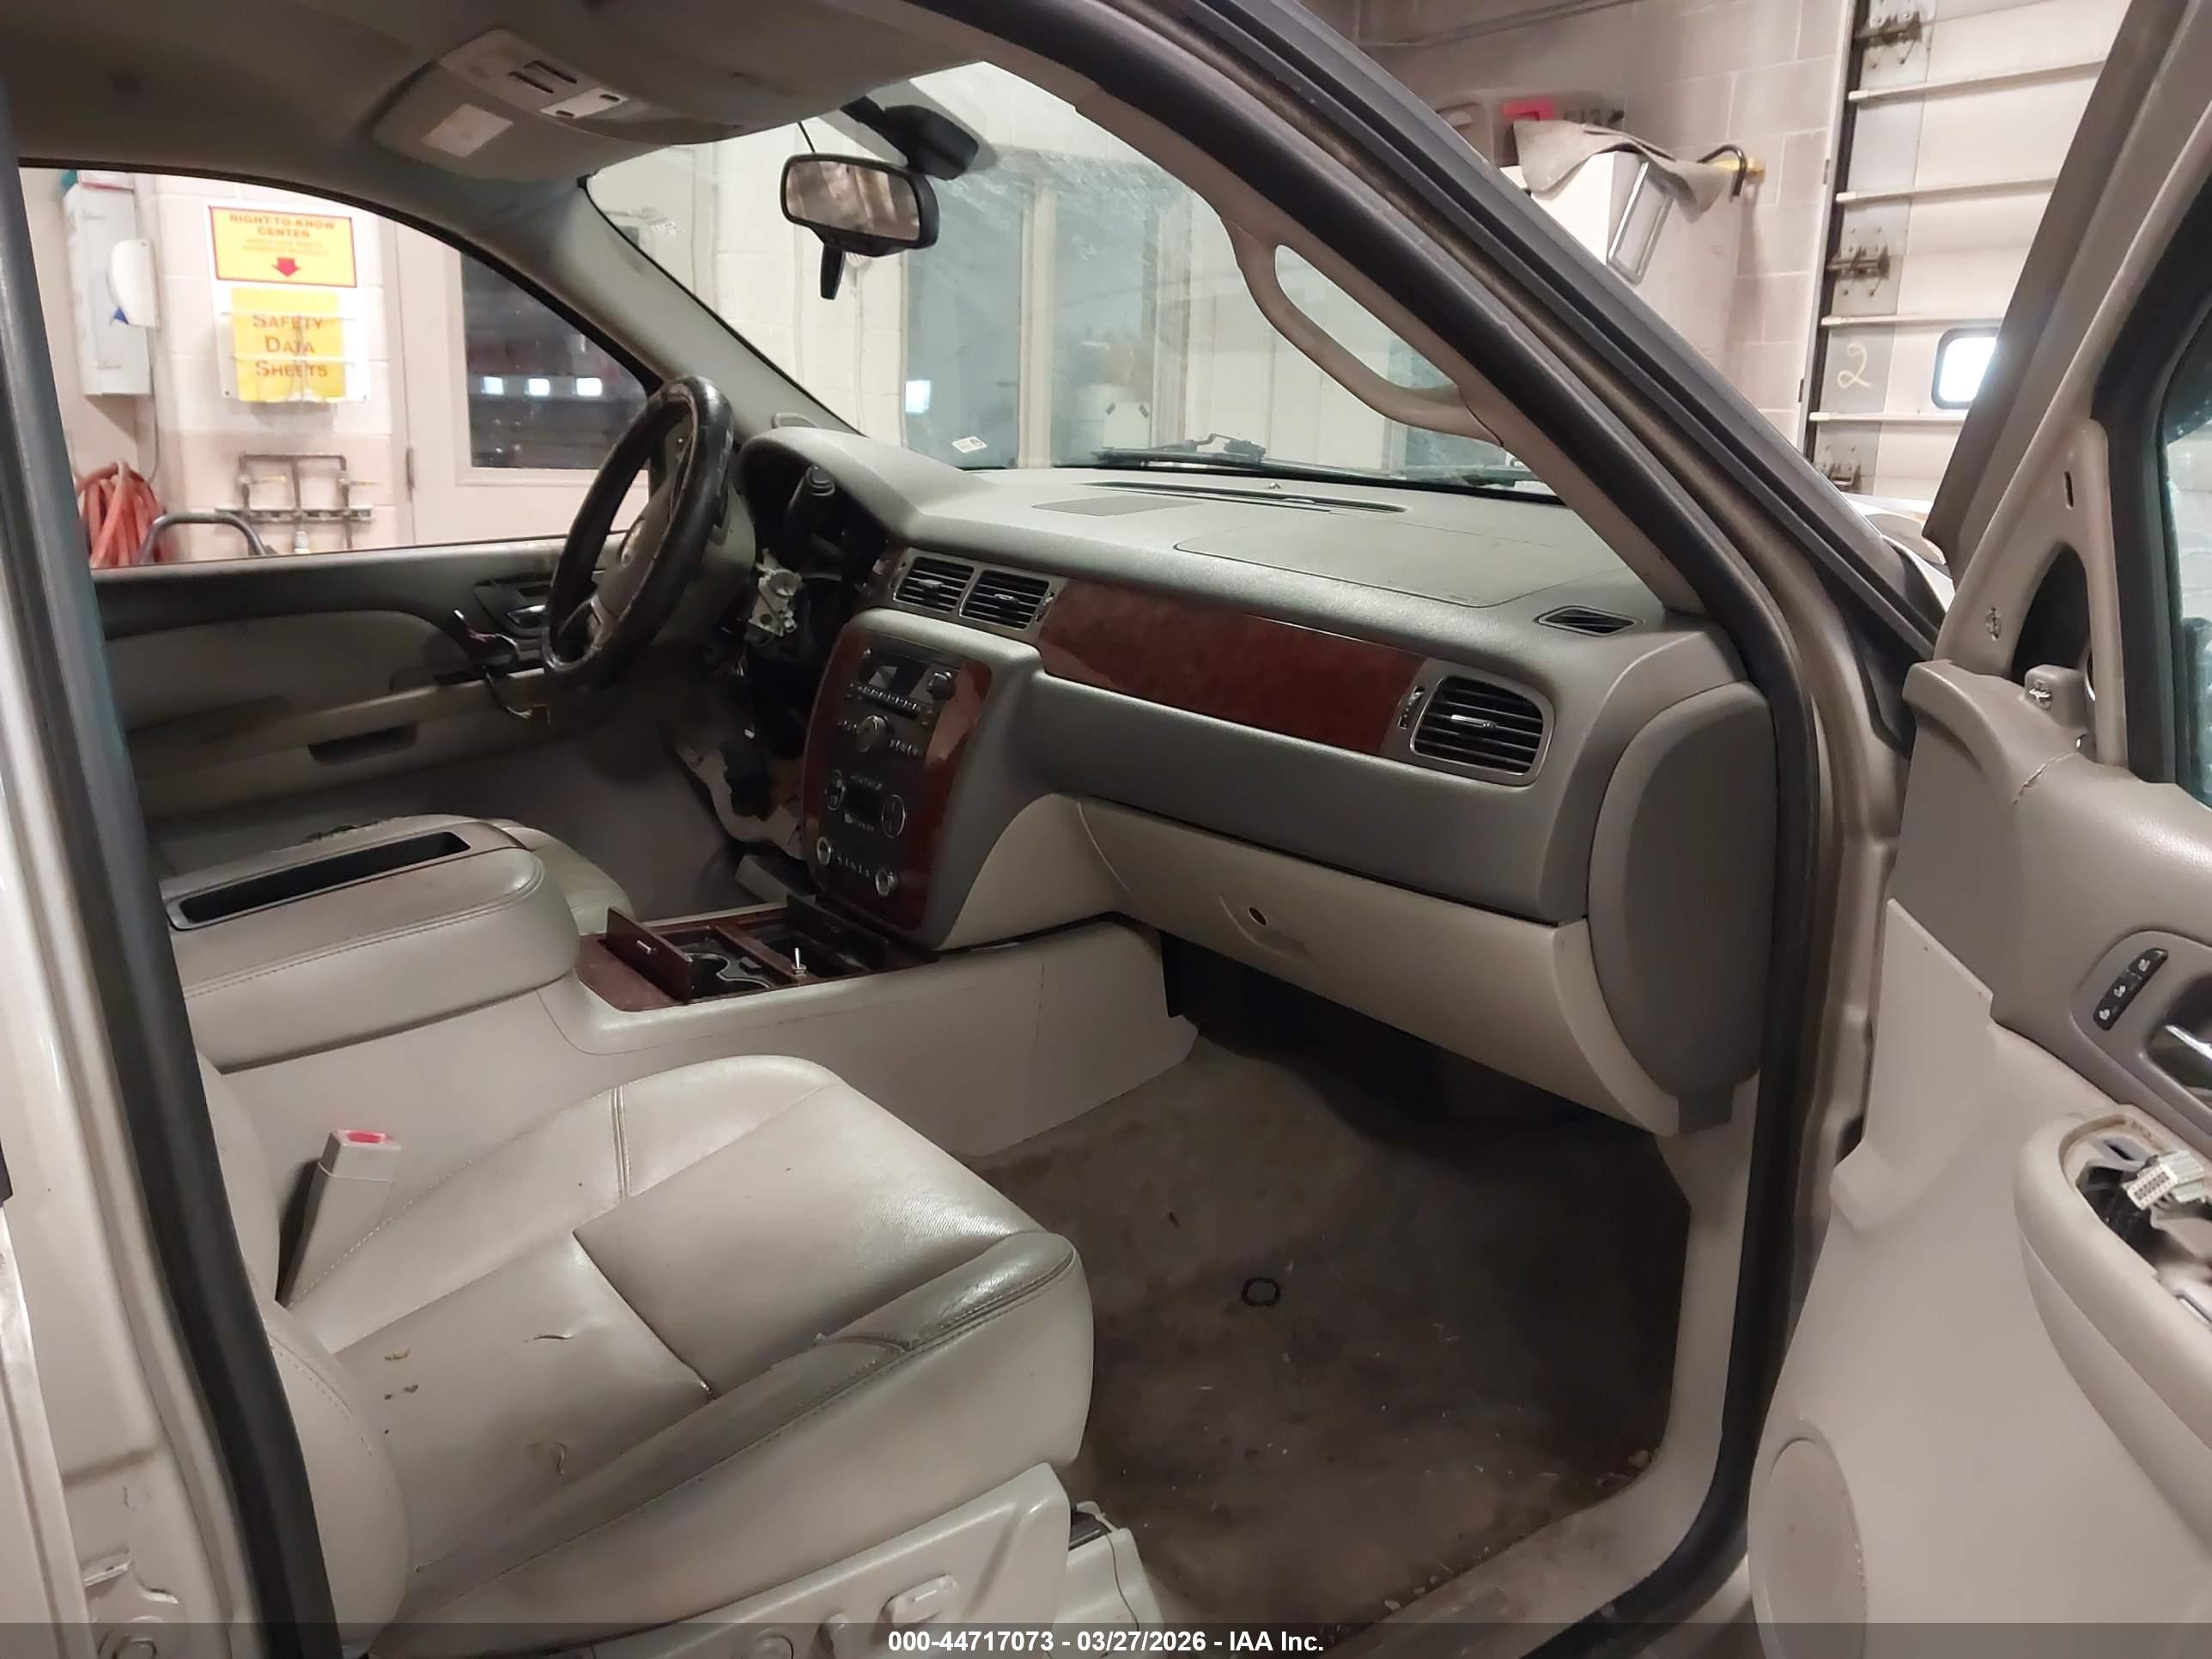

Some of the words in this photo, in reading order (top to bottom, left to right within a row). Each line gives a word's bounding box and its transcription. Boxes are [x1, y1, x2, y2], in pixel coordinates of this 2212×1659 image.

[258, 226, 310, 238] CENTER
[252, 313, 323, 330] SAFETY
[264, 336, 316, 353] DATA
[255, 359, 329, 378] SHEETS
[1837, 341, 1874, 389] 2
